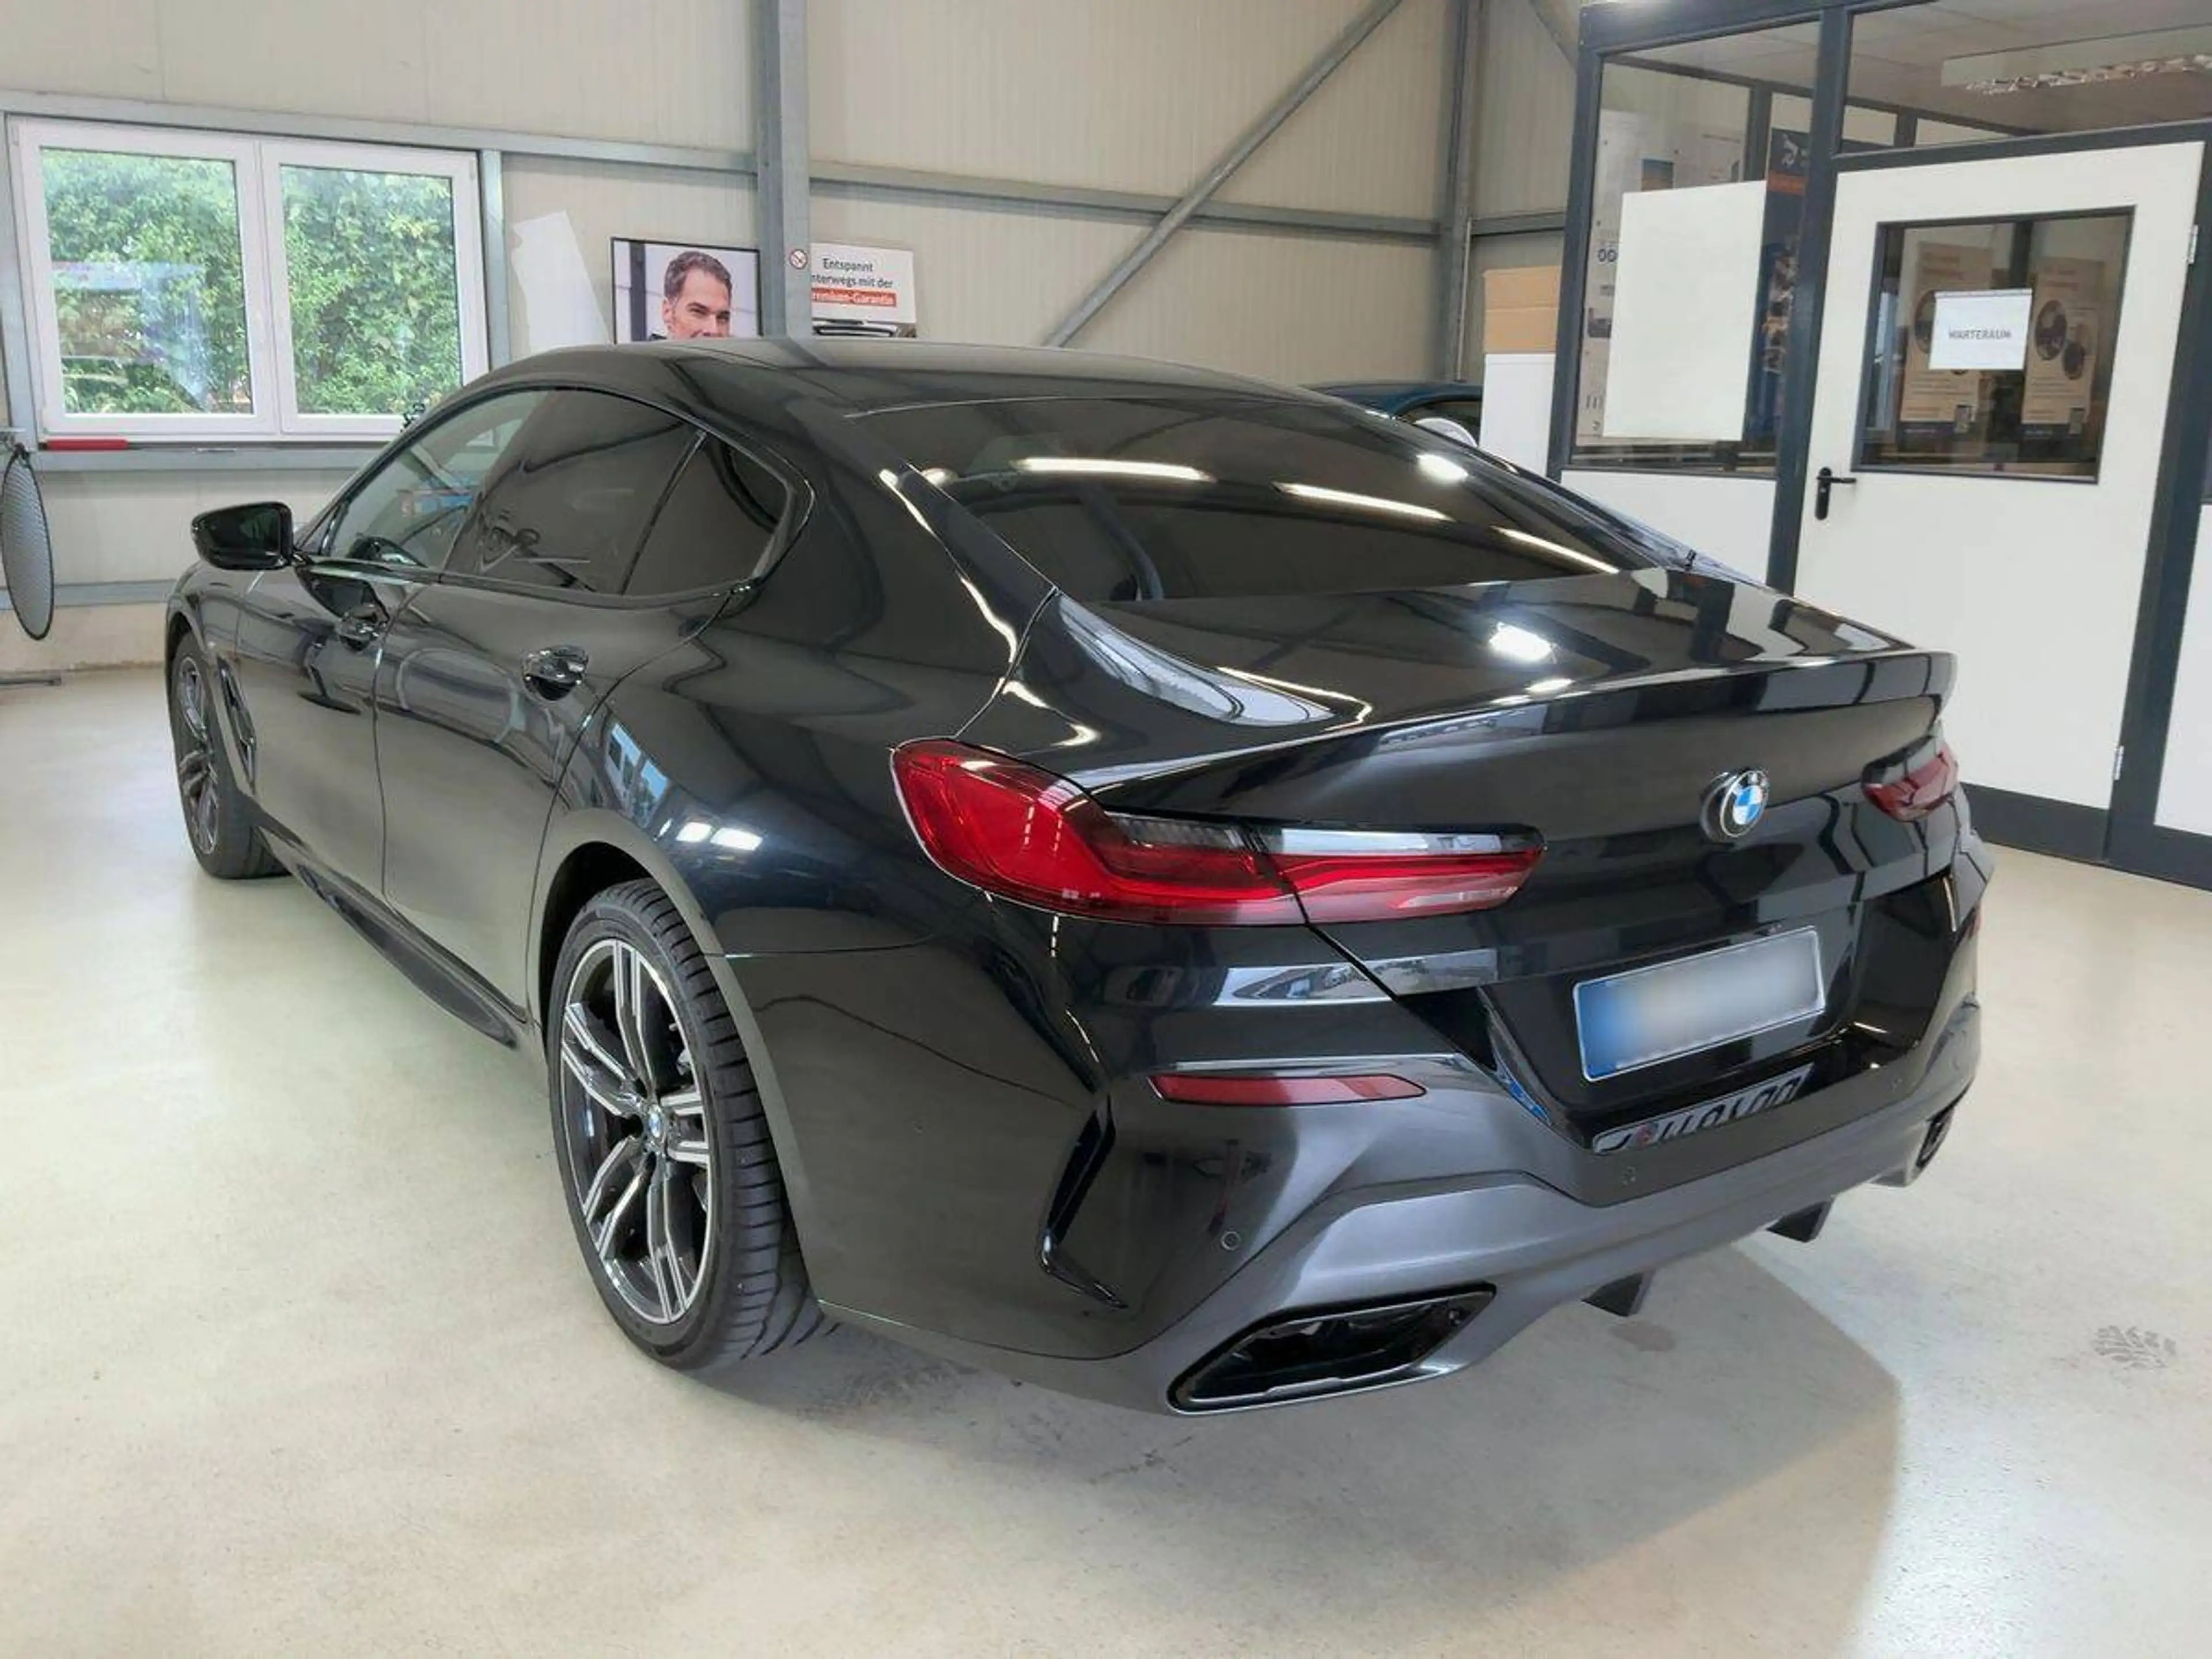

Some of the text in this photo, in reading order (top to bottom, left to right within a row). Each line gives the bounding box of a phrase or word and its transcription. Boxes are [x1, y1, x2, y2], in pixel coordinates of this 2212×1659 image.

[823, 258, 873, 271] Entspannt
[810, 274, 893, 288] nterwegs mit der
[1948, 328, 2012, 340] WARTERAUM
